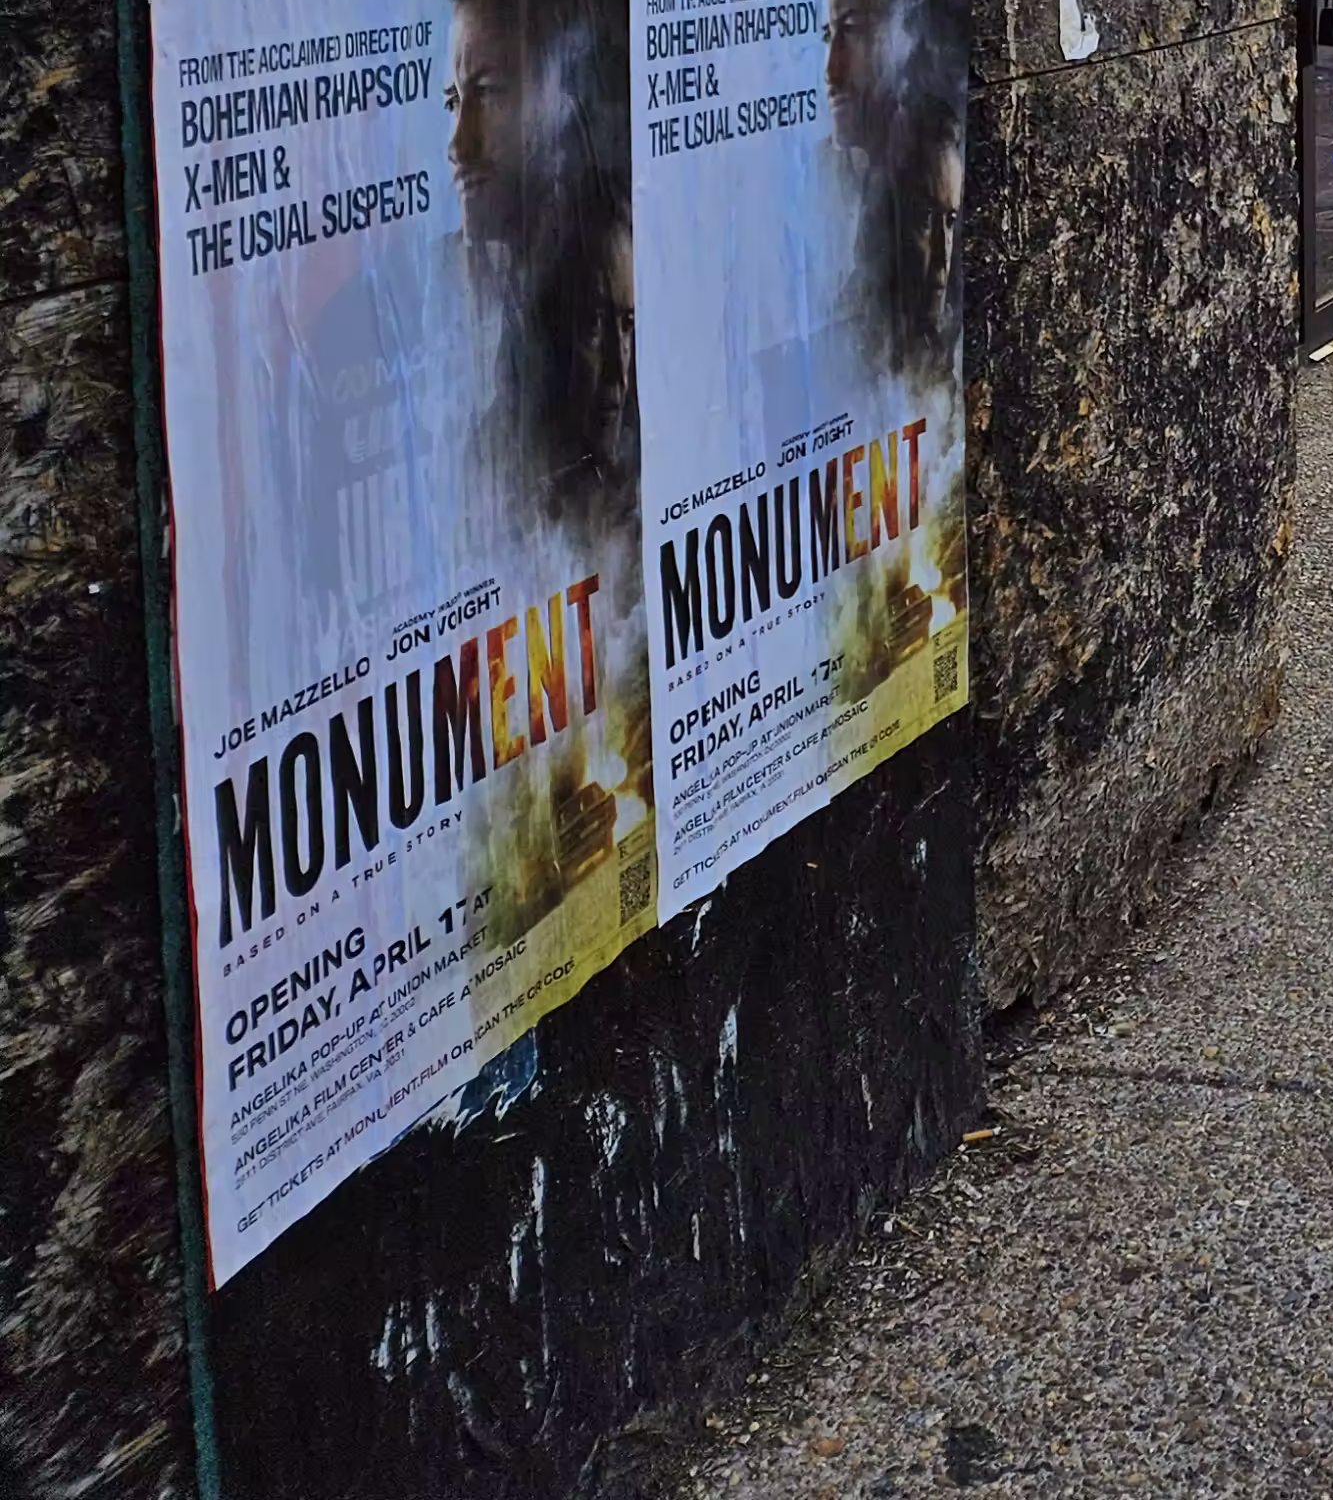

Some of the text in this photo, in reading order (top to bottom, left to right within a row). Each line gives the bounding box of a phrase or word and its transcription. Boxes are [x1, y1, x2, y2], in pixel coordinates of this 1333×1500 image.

[179, 21, 432, 88] FROM THE OF
[735, 1, 817, 45] RHAPSODY
[181, 78, 308, 148] BOHEMIAN
[706, 63, 719, 97] &
[648, 89, 816, 158] THE USUAL SUSPECTS
[185, 145, 290, 213] X-MEN &
[187, 170, 429, 276] THE USUAL SUSPECTS
[777, 442, 806, 468] JON
[661, 462, 765, 525] JOE MAZZELLO
[660, 418, 926, 670] MONUMENT
[386, 586, 501, 661] JON VOIGHT
[392, 577, 496, 635] ACADEMY WINNER
[716, 638, 745, 661] ON A
[214, 657, 370, 759] JOE MAZZELLO
[669, 670, 760, 745] OPENING
[671, 714, 743, 780] FRIDAY,
[749, 677, 804, 728] APRIL
[831, 655, 844, 671] AT
[760, 729, 773, 745] AT
[214, 573, 600, 949] MONUMENT
[723, 734, 819, 807] FILM CAFE
[673, 743, 867, 889] GET AT THE
[223, 810, 463, 978] BASED ON A TRUE STORY
[226, 927, 366, 1045] OPENING
[229, 986, 341, 1092] FRIDAY,
[350, 927, 431, 1004] APRIL
[438, 900, 467, 935] 17
[473, 888, 492, 915] AT
[230, 1061, 307, 1129] ANGELIKA
[311, 1016, 365, 1066] POP-UP
[370, 1001, 386, 1025] AT
[387, 970, 431, 1009] UNION
[235, 940, 526, 1175] ANGELIKA FILM & CAFE MOSAIC
[237, 994, 525, 1233] GET TICKETS AT OR THE
